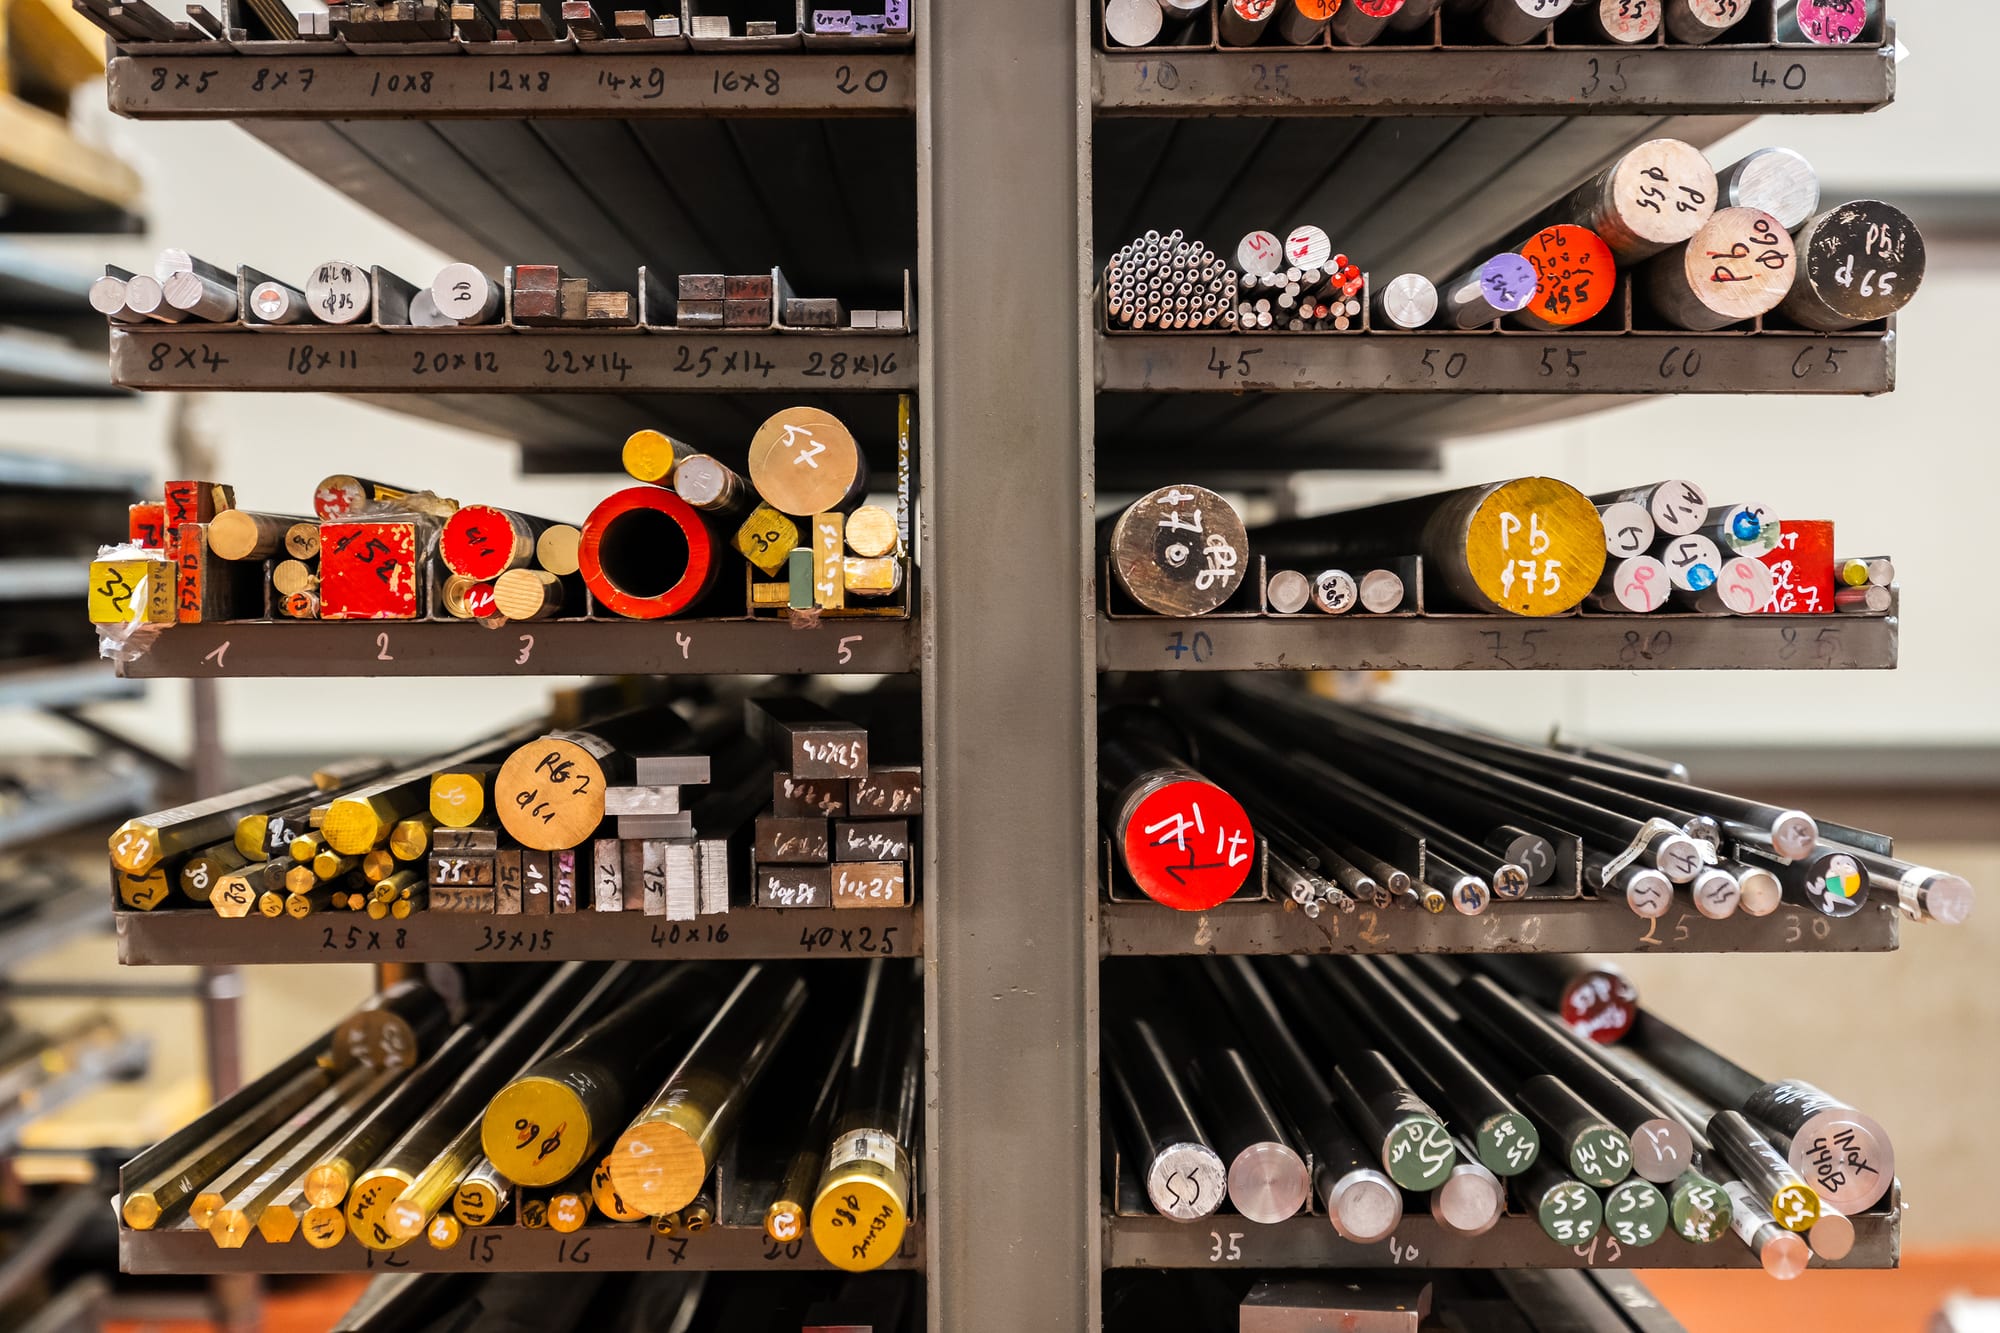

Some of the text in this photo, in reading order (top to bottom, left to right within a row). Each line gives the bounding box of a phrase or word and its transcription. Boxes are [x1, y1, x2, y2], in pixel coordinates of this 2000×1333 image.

[151, 67, 218, 93] 8x5
[252, 68, 314, 92] 8x7
[371, 71, 434, 96] 10x8
[488, 67, 550, 93] 12x8
[598, 67, 664, 98] 14x9
[714, 68, 780, 96] 16x8
[836, 65, 888, 94] 20
[1752, 62, 1806, 90] 40
[148, 342, 229, 373] 8x4
[288, 347, 356, 375] 18x11
[413, 351, 499, 374] 20x12
[544, 349, 632, 382] 22x14
[673, 345, 775, 377] 25x14
[1207, 345, 1263, 380] 45
[1420, 348, 1467, 379] 50
[1537, 347, 1587, 378] 55
[1659, 346, 1700, 379] 60
[752, 530, 780, 553] 30
[1500, 512, 1551, 555] Pb
[376, 632, 394, 660] 2
[515, 634, 534, 665] 3
[676, 631, 691, 659] 4
[837, 635, 863, 664] 5
[1165, 631, 1213, 663] 70
[1480, 628, 1550, 660] 75
[652, 924, 729, 948] 40x16
[800, 927, 898, 954] 40x25
[470, 1235, 502, 1262] 15
[558, 1238, 591, 1263] 16
[646, 1234, 689, 1264] 17
[1209, 1231, 1245, 1262] 35
[1389, 1236, 1419, 1264] 40
